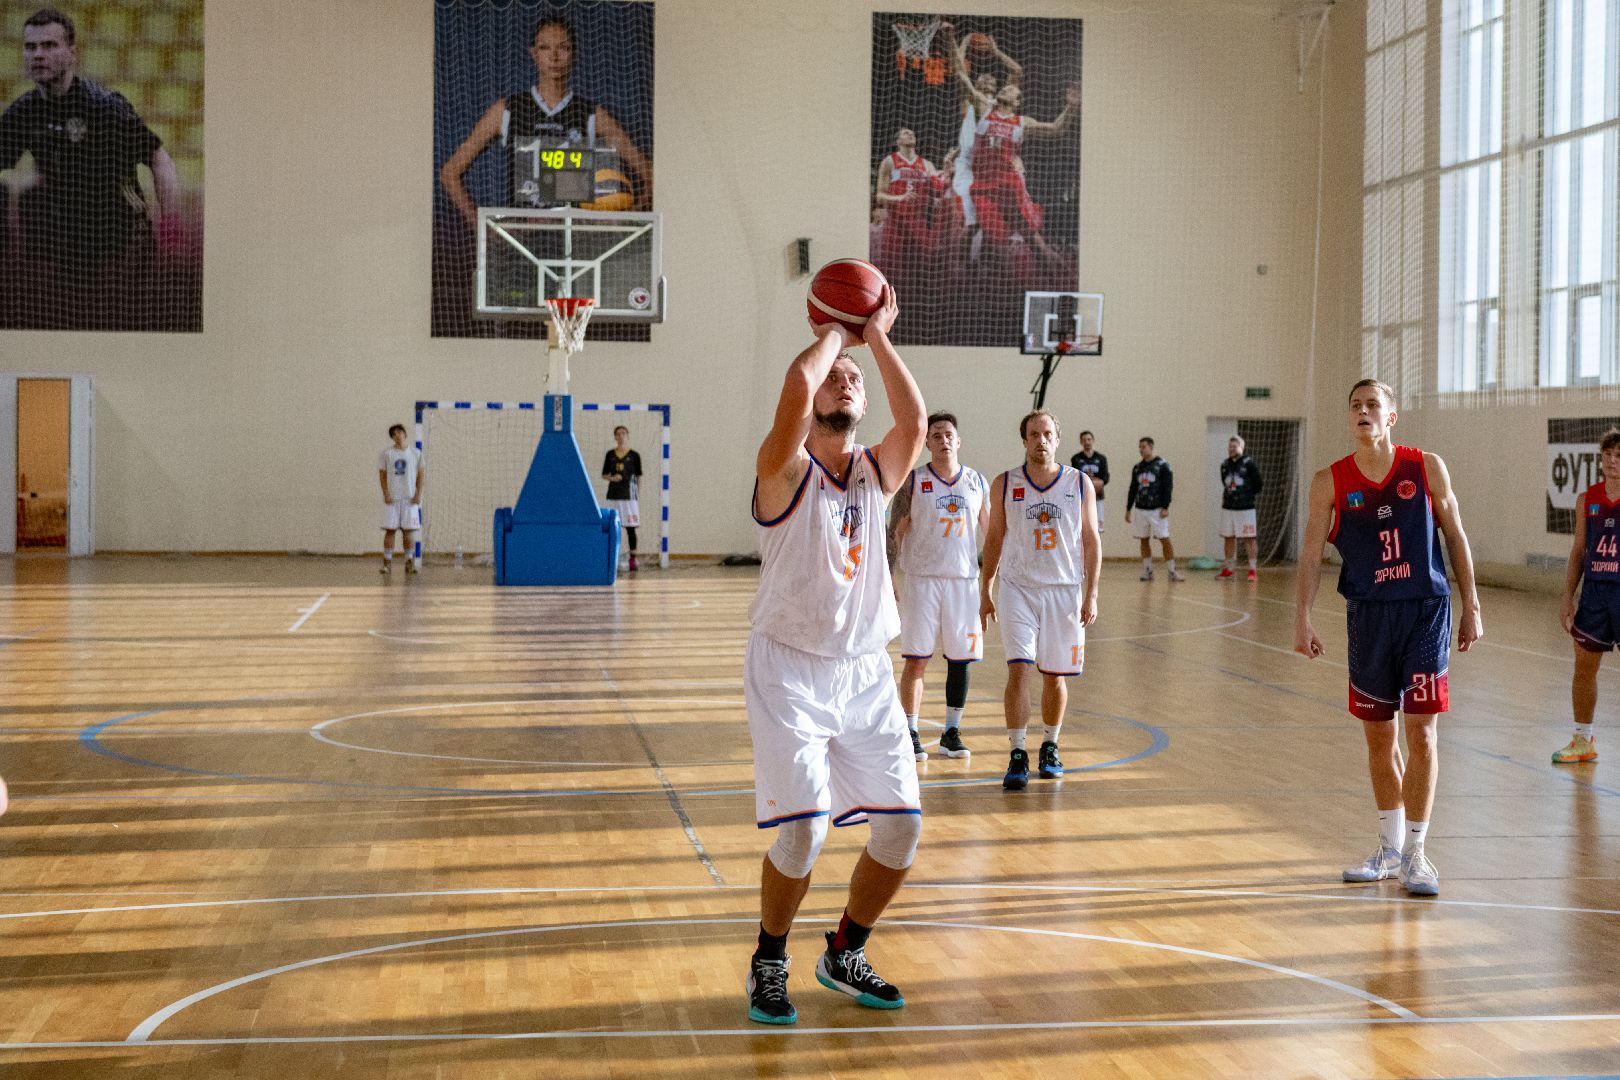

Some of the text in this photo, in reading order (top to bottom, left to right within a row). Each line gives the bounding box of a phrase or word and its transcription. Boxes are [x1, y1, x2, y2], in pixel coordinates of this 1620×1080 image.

[541, 150, 582, 169] 48 4
[939, 517, 964, 538] 77
[1034, 528, 1057, 550] 13
[1378, 528, 1401, 562] 31
[1595, 534, 1618, 557] 44
[1412, 672, 1437, 702] 31
